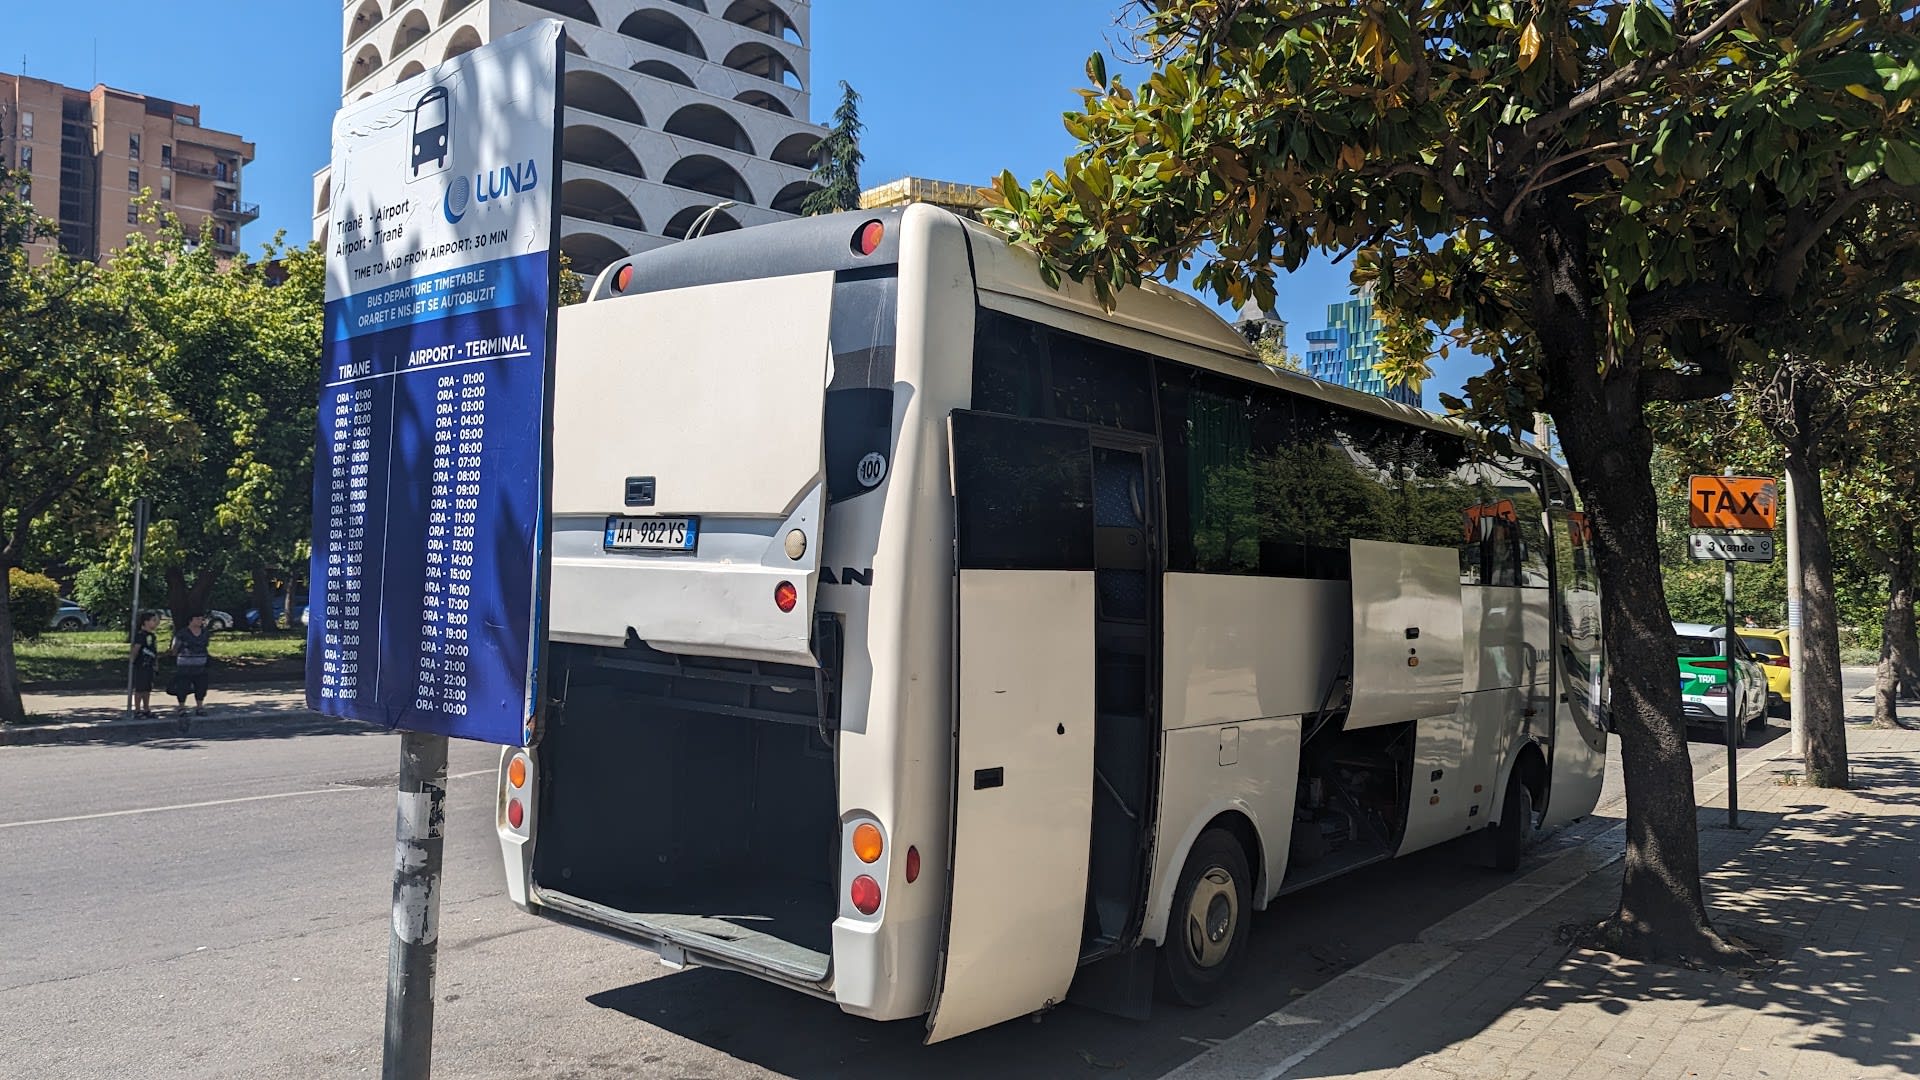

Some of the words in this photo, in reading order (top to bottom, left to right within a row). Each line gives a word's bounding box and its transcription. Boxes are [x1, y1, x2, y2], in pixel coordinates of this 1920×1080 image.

[477, 159, 537, 202] LUNA
[337, 214, 362, 234] Tiranë
[376, 198, 409, 222] Airport
[336, 236, 366, 257] Airport
[375, 223, 402, 246] Tiranë
[354, 266, 371, 280] TIME
[374, 264, 382, 274] TO
[385, 258, 401, 272] AND
[404, 250, 427, 266] FROM
[430, 238, 472, 258] AIRPORT:
[475, 235, 486, 248] 30
[490, 230, 508, 245] MIN
[368, 295, 382, 308] BUS
[384, 282, 432, 304] DEPARTURE
[434, 269, 485, 291] TIMETABLE
[358, 310, 389, 327] ORARET
[391, 309, 396, 319] E
[398, 300, 426, 318] NISJET
[428, 298, 438, 311] SE
[441, 286, 495, 307] AUTOBUZIT
[408, 344, 455, 366] AIRPORT
[465, 334, 527, 357] TERMINAL
[339, 360, 371, 379] TIRANE
[438, 376, 454, 387] ORA
[463, 372, 484, 384] 01:00
[337, 393, 349, 403] ORA
[356, 389, 371, 400] 01:00
[437, 390, 453, 400] ORA
[462, 386, 485, 398] 02:00
[336, 405, 348, 415] ORA
[355, 401, 371, 412] 02:00
[437, 404, 453, 414] ORA
[461, 400, 484, 412] 03:00
[335, 417, 348, 427] ORA
[436, 417, 452, 428] ORA
[461, 414, 484, 426] 04:00
[335, 430, 347, 440] ORA
[353, 427, 370, 437] 04:00
[435, 431, 451, 441] ORA
[460, 428, 483, 439] 05:00
[334, 443, 346, 452] ORA
[353, 440, 369, 450] 05:00
[435, 444, 450, 455] ORA
[459, 442, 482, 453] 06:00
[333, 455, 345, 465] ORA
[352, 452, 369, 462] 06:00
[434, 458, 450, 468] ORA
[458, 457, 480, 467] 07:00
[332, 468, 345, 477] ORA
[351, 465, 368, 475] 07:00
[862, 460, 880, 478] 100
[433, 472, 448, 482] ORA
[457, 471, 480, 481] 08:00
[332, 480, 344, 489] ORA
[350, 478, 367, 488] 08:00
[432, 485, 448, 496] ORA
[456, 485, 479, 495] 09:00
[331, 493, 344, 502] ORA
[431, 499, 447, 509] ORA
[456, 499, 477, 509] 10:00
[331, 506, 343, 514] ORA
[350, 503, 365, 513] 10:00
[331, 518, 343, 527] ORA
[349, 516, 363, 525] 11:00
[430, 513, 446, 523] ORA
[455, 513, 475, 523] 11:00
[330, 530, 342, 539] ORA
[349, 528, 363, 538] 12:00
[429, 526, 444, 536] ORA
[454, 526, 474, 537] 12:00
[617, 522, 632, 542] AA
[330, 543, 342, 551] ORA
[428, 540, 443, 550] ORA
[453, 540, 473, 552] 13:00
[1708, 542, 1715, 551] 3
[1720, 542, 1755, 552] vende
[329, 555, 341, 564] ORA
[347, 554, 362, 563] 14:00
[427, 553, 442, 564] ORA
[451, 554, 473, 566] 14:00
[328, 567, 340, 576] ORA
[426, 567, 441, 578] ORA
[450, 568, 471, 580] 15:00
[820, 566, 873, 586] AN
[328, 581, 340, 590] ORA
[425, 582, 440, 593] ORA
[449, 584, 470, 596] 16:00
[328, 594, 339, 602] ORA
[346, 593, 360, 602] 17:00
[424, 596, 439, 607] ORA
[448, 598, 468, 610] 17:00
[327, 607, 339, 615] ORA
[423, 610, 438, 621] ORA
[447, 612, 468, 625] 18:00
[326, 620, 338, 629] ORA
[326, 634, 337, 644] ORA
[343, 635, 359, 645] 20:00
[422, 626, 437, 636] ORA
[446, 628, 467, 640] 19:00
[325, 649, 337, 660] ORA
[342, 651, 357, 660] 21:00
[421, 642, 436, 652] ORA
[445, 644, 468, 656] 20:00
[324, 662, 336, 673] ORA
[341, 664, 357, 673] 22:00
[421, 658, 435, 669] ORA
[445, 660, 465, 672] 21:00
[323, 675, 335, 685] ORA
[340, 677, 356, 686] 23:00
[420, 671, 435, 684] ORA
[444, 675, 466, 686] 22:00
[1698, 674, 1715, 683] TAXI
[322, 688, 333, 698] ORA
[339, 689, 356, 699] 00:00
[419, 685, 434, 697] ORA
[444, 689, 466, 700] 23:00
[416, 699, 433, 711] ORA
[443, 703, 467, 715] 00:00
